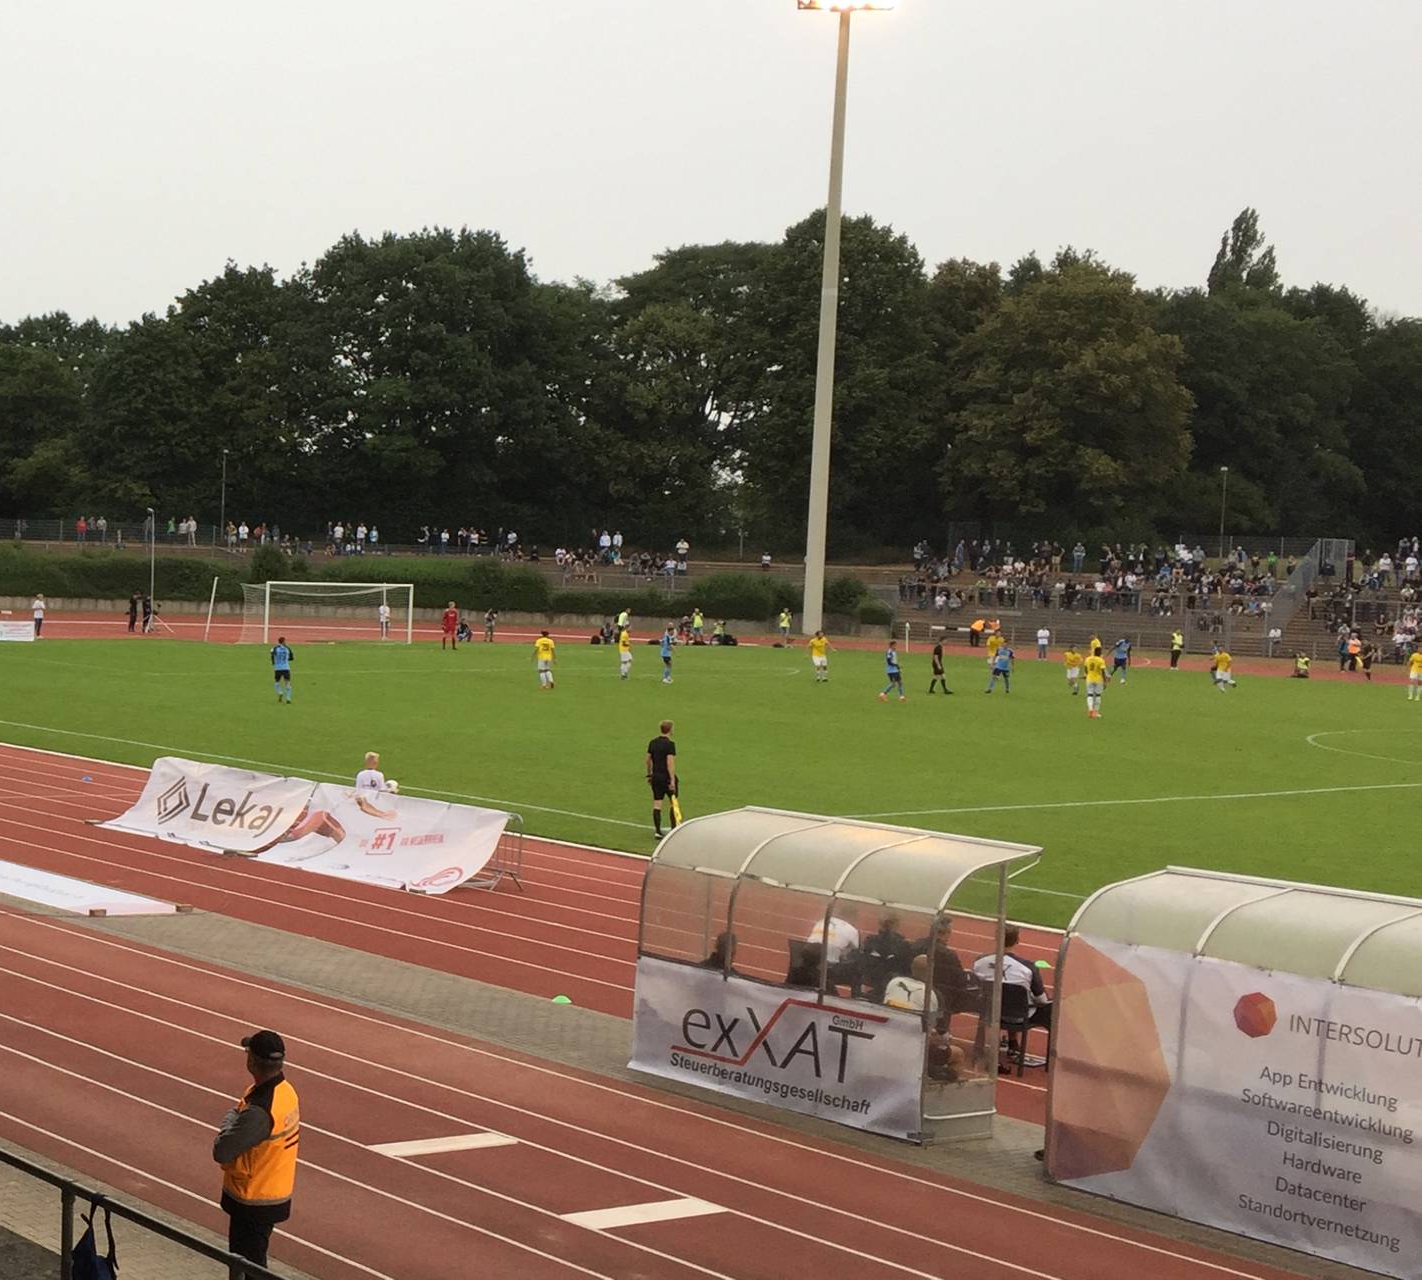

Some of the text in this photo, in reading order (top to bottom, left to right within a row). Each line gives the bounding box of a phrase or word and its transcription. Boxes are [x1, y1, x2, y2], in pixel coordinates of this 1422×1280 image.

[190, 782, 284, 838] Lekaj
[832, 1014, 864, 1031] GmbH
[670, 1052, 872, 1116] Steuerberatungsgesellschaft
[1259, 1066, 1399, 1113] App Entwicklung
[1241, 1088, 1414, 1144] Softwareentwicklung
[1267, 1119, 1383, 1165] Digitalisierung
[1283, 1151, 1363, 1184] Hardware
[1275, 1176, 1367, 1213] Datacenter
[1238, 1194, 1401, 1253] Standortvernetzung
